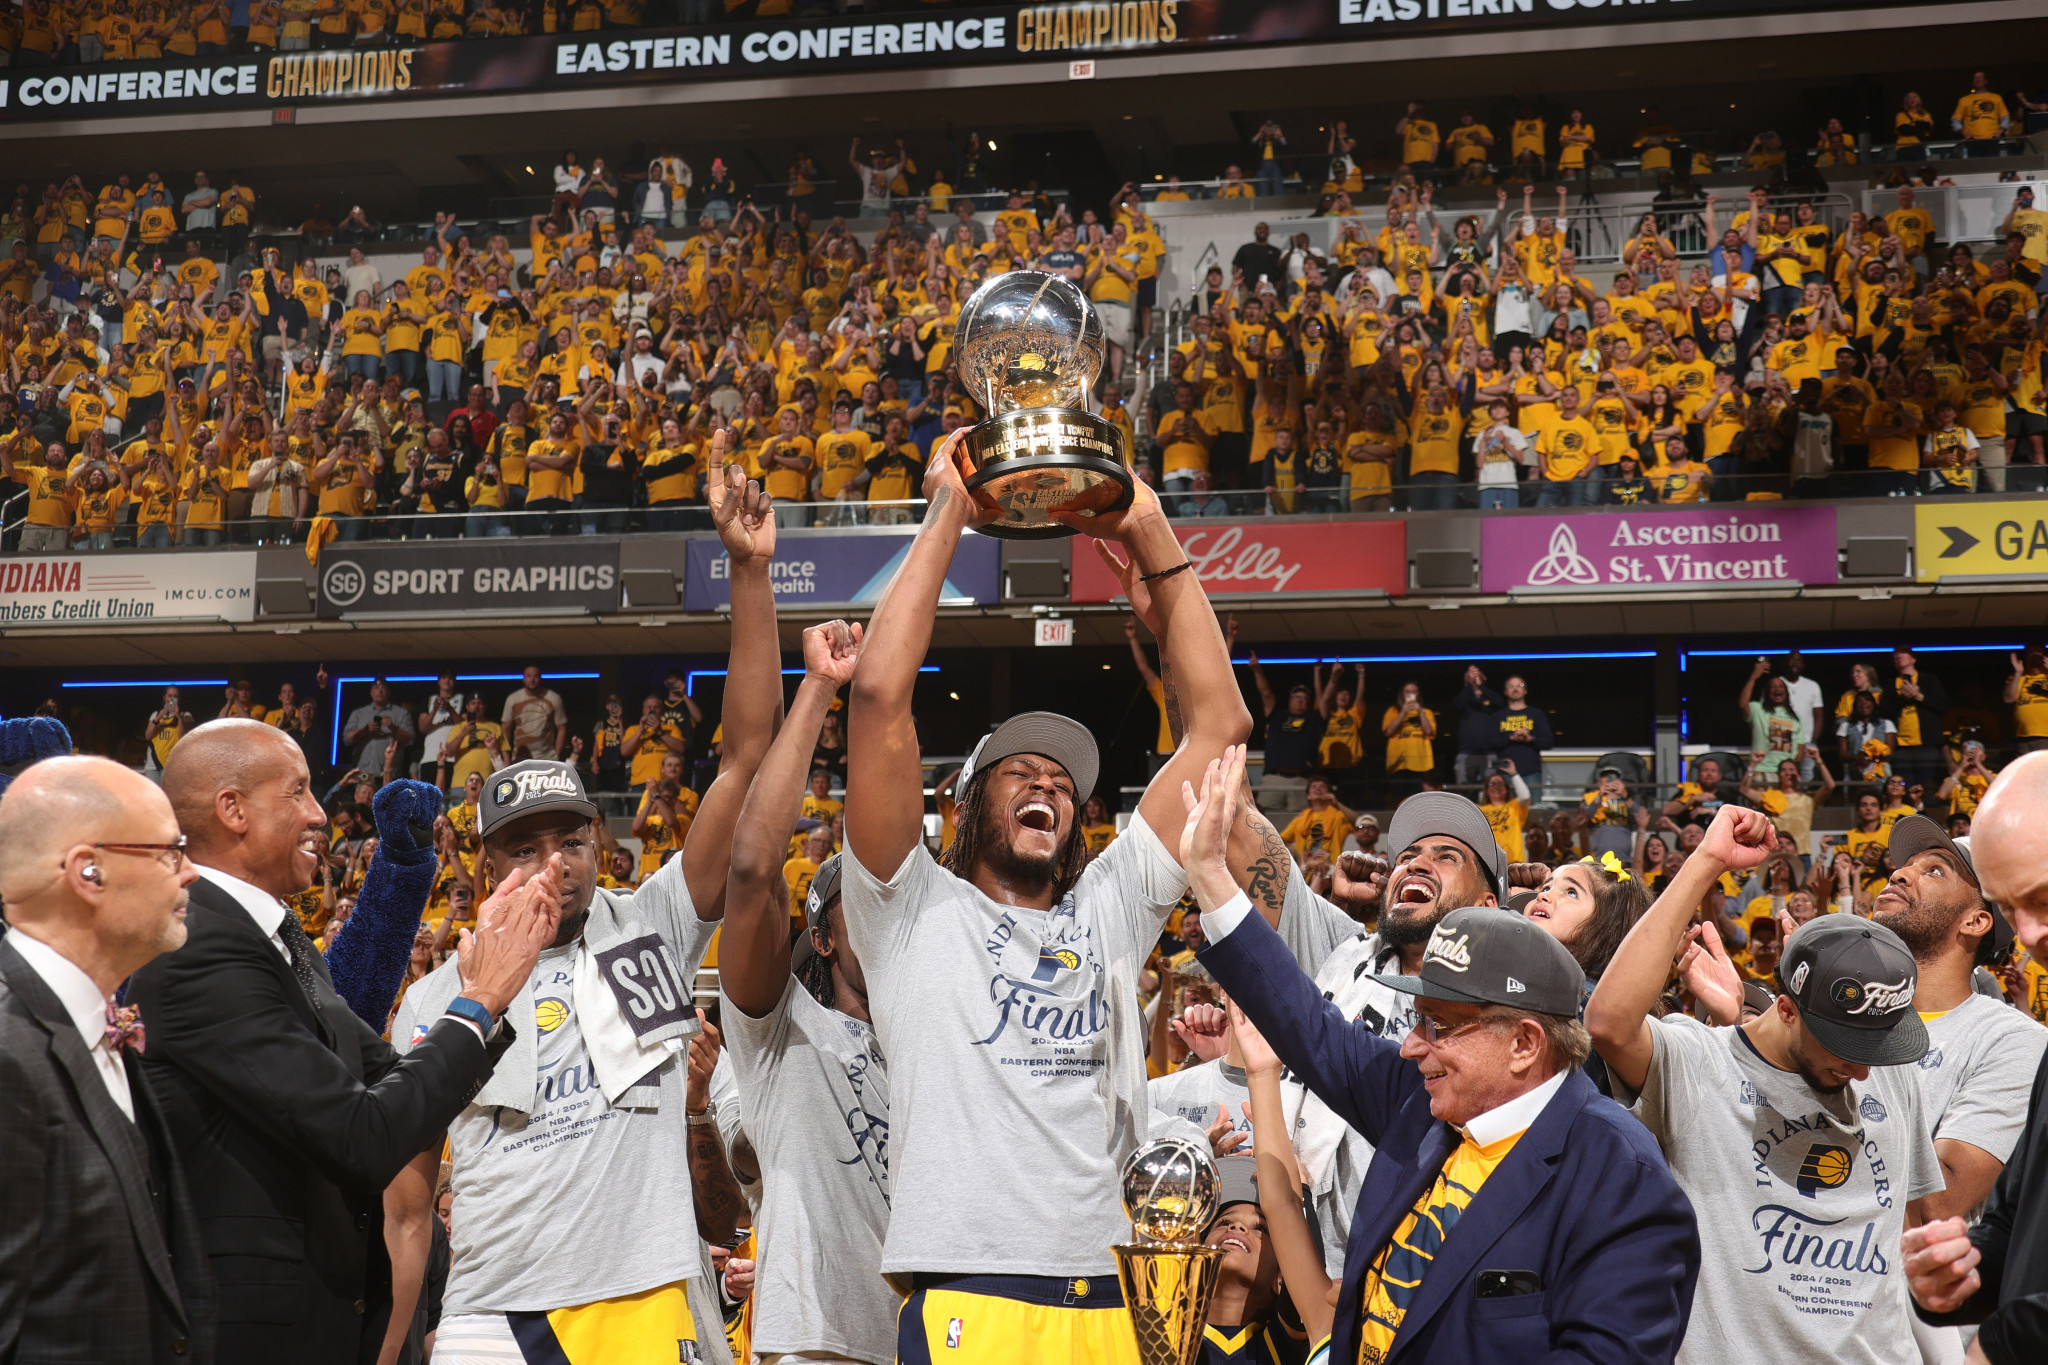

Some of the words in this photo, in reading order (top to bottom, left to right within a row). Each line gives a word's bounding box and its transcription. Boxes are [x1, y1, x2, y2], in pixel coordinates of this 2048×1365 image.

[556, 34, 731, 75] EASTERN
[741, 16, 1006, 63] CONFERENCE
[1016, 0, 1179, 53] CHAMPIONS
[18, 65, 257, 107] CONFERENCE
[266, 50, 412, 98] CHAMPIONS
[1610, 516, 1782, 547] Ascension
[710, 558, 816, 580] Elnce
[1183, 527, 1301, 592] Lilly
[1609, 555, 1653, 583] St.
[1654, 553, 1789, 582] Vincent
[330, 572, 358, 594] SG
[373, 568, 464, 595] SPORT
[473, 564, 615, 593] GRAPHICS
[773, 578, 815, 594] ealth
[165, 588, 251, 600] IMCU.COM
[51, 600, 102, 620] Credit
[107, 598, 154, 617] Union
[1042, 624, 1068, 642] EXIT
[510, 767, 577, 807] Finals
[525, 791, 542, 800] 2025
[1868, 1007, 1884, 1016] 2025
[1000, 1057, 1053, 1067] EASTERN
[1055, 1058, 1105, 1067] CONFEREN
[1054, 1047, 1076, 1055] NBA
[1030, 1069, 1092, 1078] CHAMPIONS
[527, 1109, 554, 1125] 2024
[563, 1100, 590, 1113] 2025
[549, 1116, 572, 1128] NBA
[503, 1132, 551, 1153] EASTERN
[553, 1112, 618, 1136] CONFERENCE
[533, 1128, 594, 1153] CHAMPIONS
[1752, 1111, 1832, 1188] INDIANA
[1853, 1128, 1893, 1210] ACERS
[1742, 1204, 1890, 1276] Finals
[1790, 1273, 1816, 1282] 2024
[1825, 1276, 1851, 1287] 2025
[1809, 1285, 1831, 1295] NBA
[1810, 1297, 1873, 1310] CONFERENC
